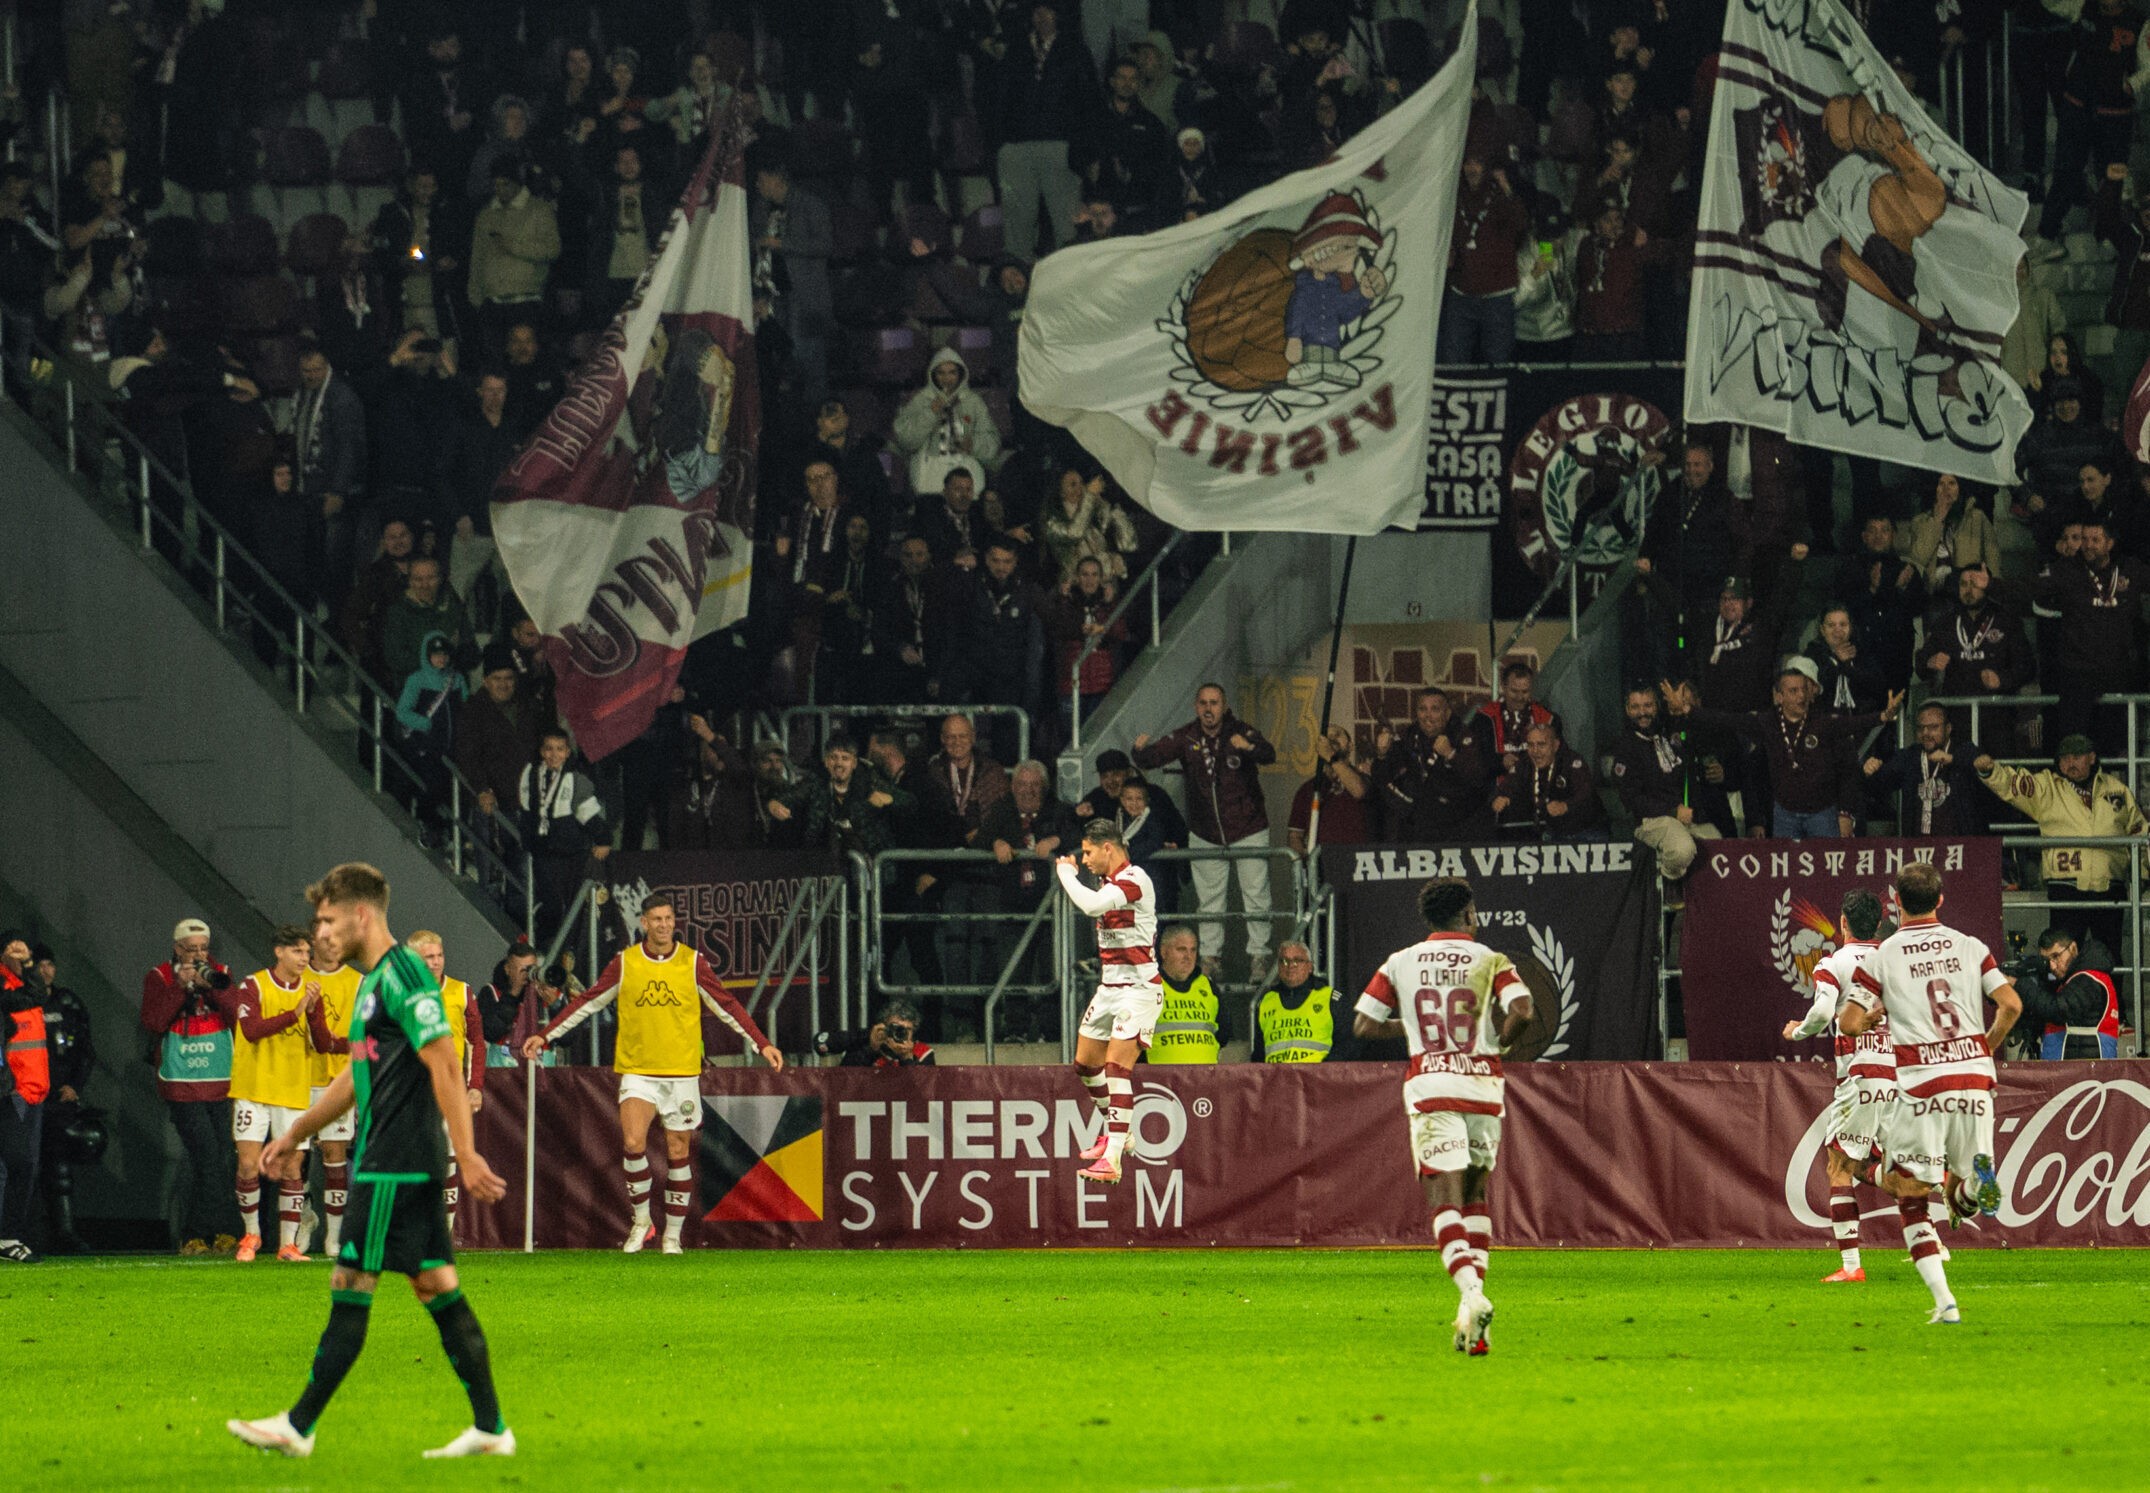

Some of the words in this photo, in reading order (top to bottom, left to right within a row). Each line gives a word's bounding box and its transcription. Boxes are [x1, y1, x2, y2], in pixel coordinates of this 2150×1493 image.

[1353, 848, 1467, 882] ALBA
[1471, 842, 1633, 885] VIȘINIE
[2057, 851, 2083, 872] 24
[1902, 939, 1953, 955] mogo
[1418, 951, 1473, 967] mogo
[1909, 957, 1962, 978] KRAMER
[1435, 969, 1469, 986] LATIF
[1165, 999, 1206, 1011] LIBRA
[1927, 978, 1960, 1041] 6
[1163, 1010, 1210, 1022] GUARD
[1272, 1017, 1311, 1031] LIBRA
[1414, 988, 1478, 1053] 66
[1269, 1029, 1313, 1042] GUARD
[181, 1042, 215, 1054] FOTO
[1856, 1035, 1895, 1053] PLUS-AU
[187, 1056, 209, 1068] 906
[1913, 1096, 1986, 1117] DACRIS
[237, 1110, 252, 1126] 55
[839, 1088, 1188, 1164] THERMO
[1840, 1132, 1872, 1146] DACR
[1896, 1153, 1944, 1166] DACRIS
[292, 1197, 303, 1210] R
[331, 1191, 345, 1204] R
[670, 1193, 684, 1203] R
[841, 1168, 1183, 1232] SYSTEM
